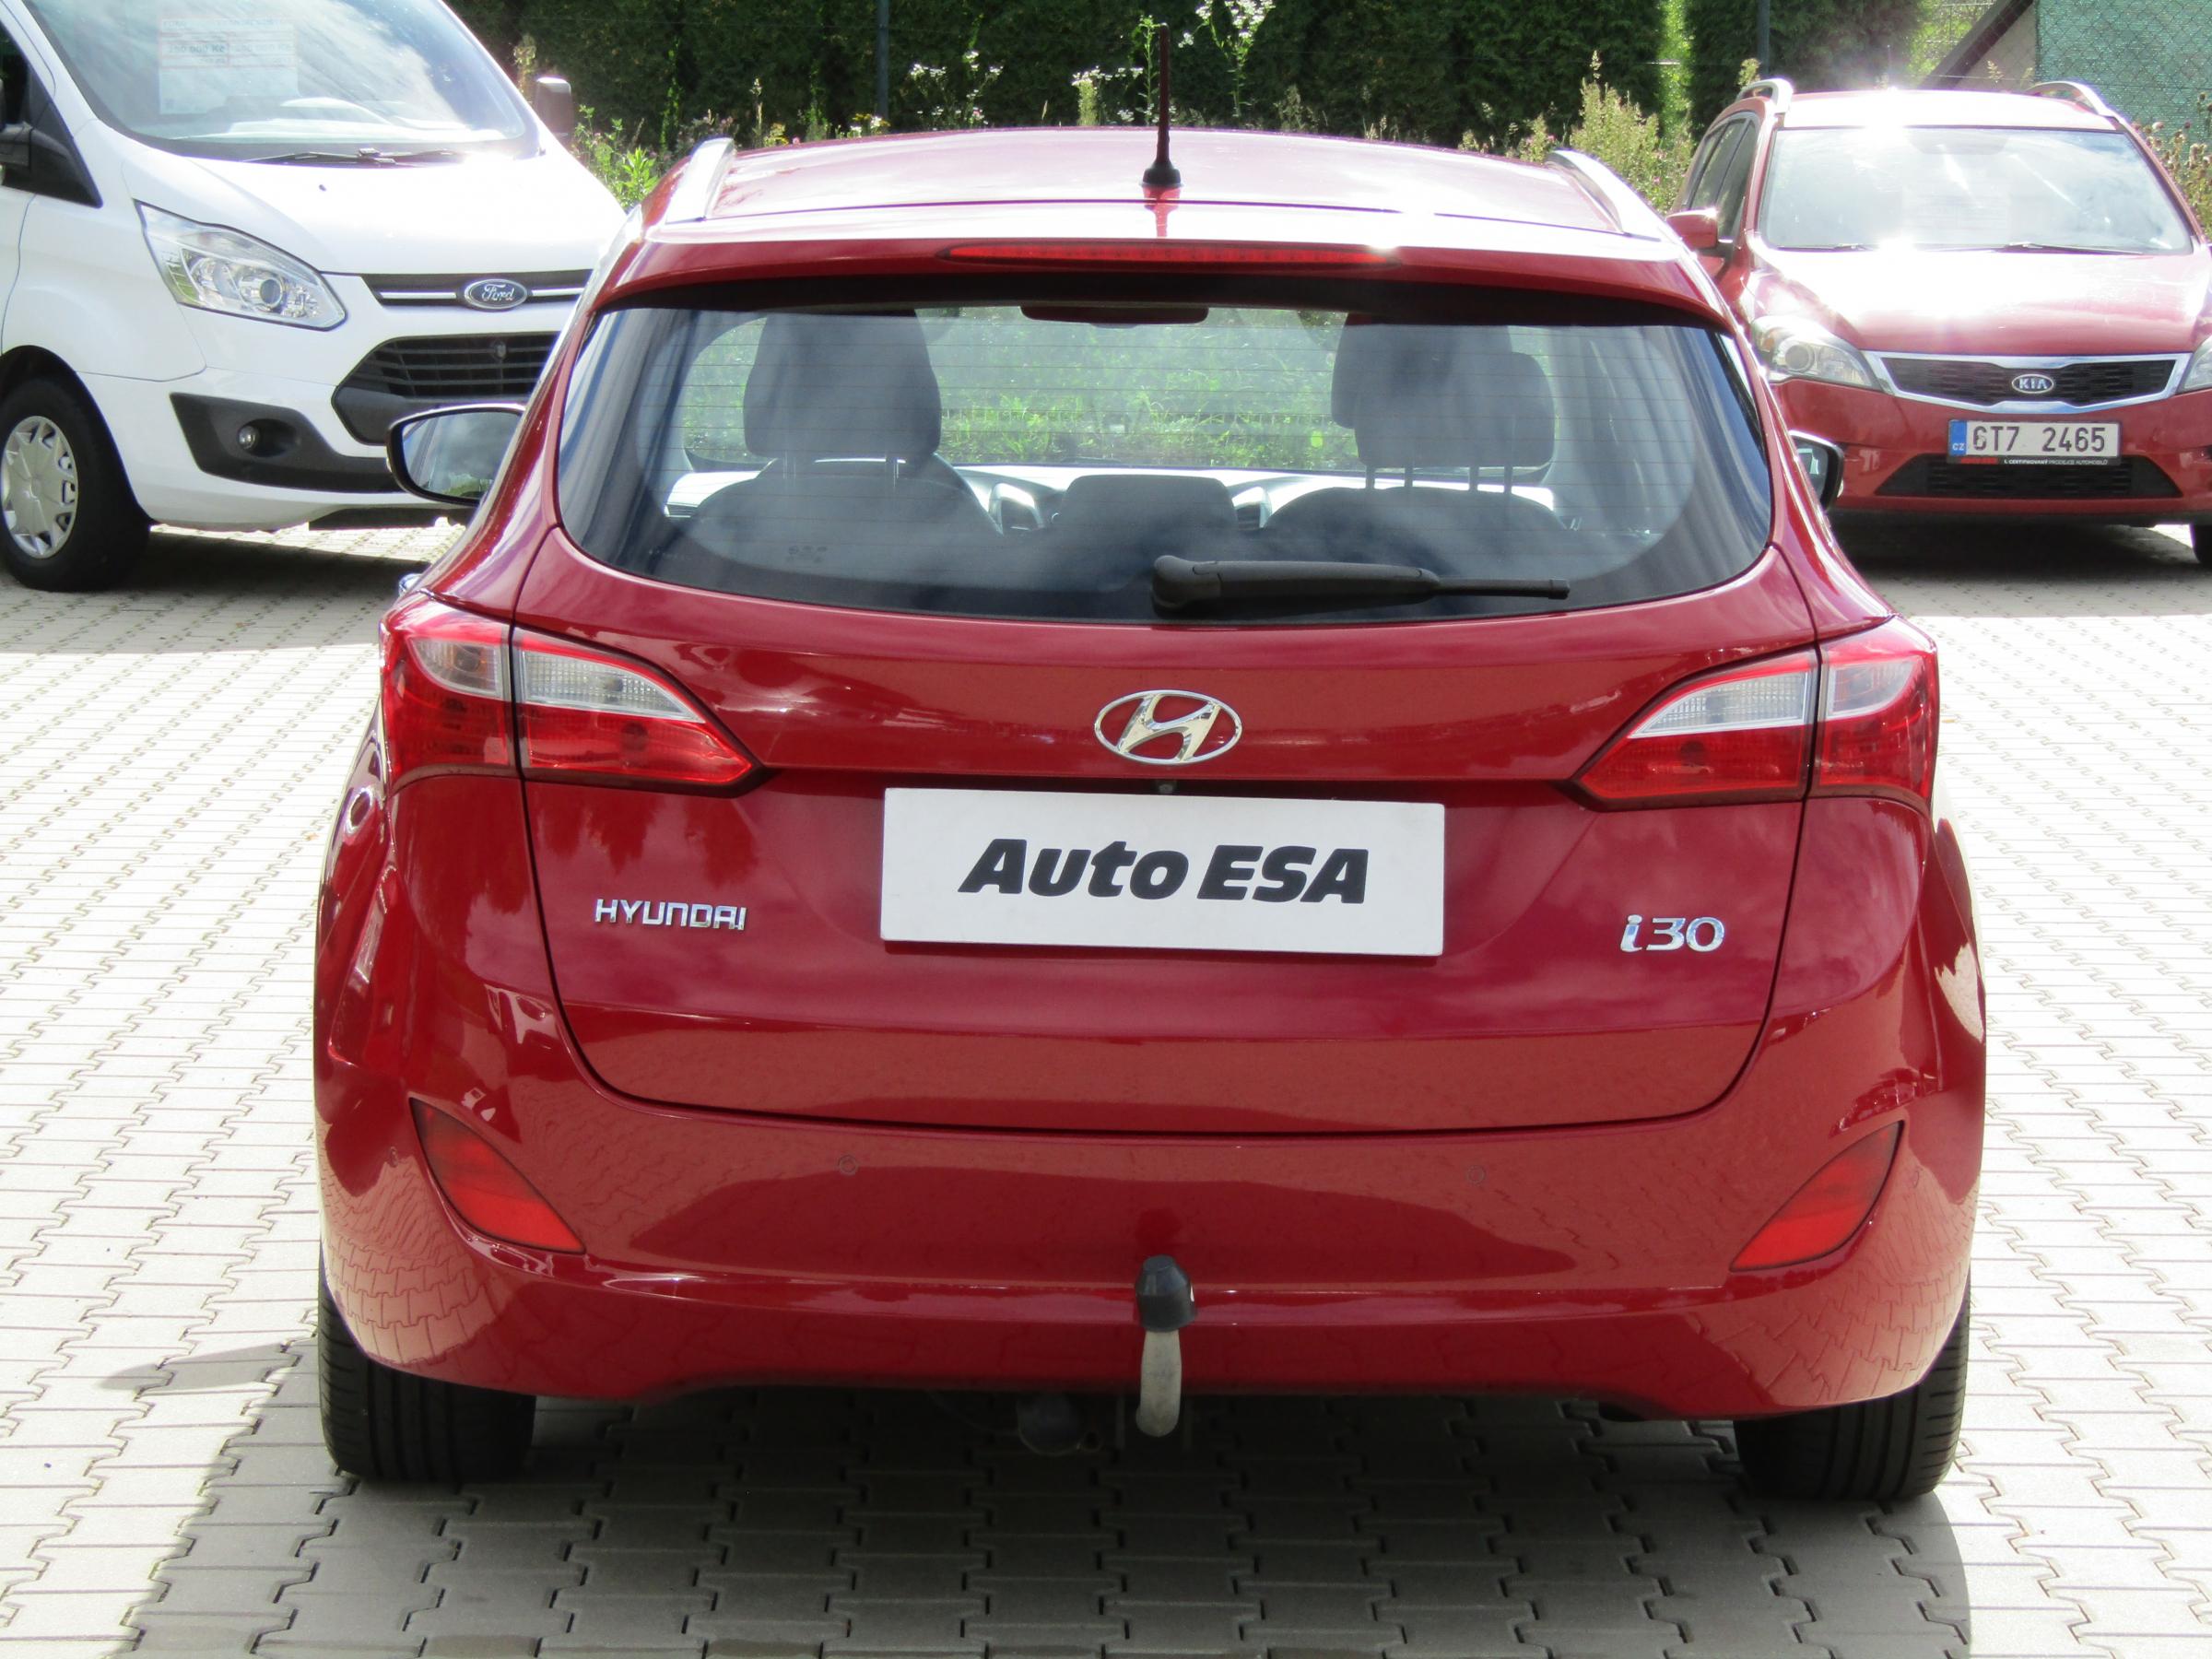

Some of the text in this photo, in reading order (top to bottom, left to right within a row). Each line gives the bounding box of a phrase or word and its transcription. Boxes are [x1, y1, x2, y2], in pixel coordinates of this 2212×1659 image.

[481, 283, 515, 301] Ford
[2018, 377, 2048, 390] KIA
[1952, 426, 2106, 453] CZ 6T7 2465
[957, 837, 1370, 905] Auto ESA
[594, 899, 747, 931] HYUNDAI
[1620, 914, 1725, 952] i30
